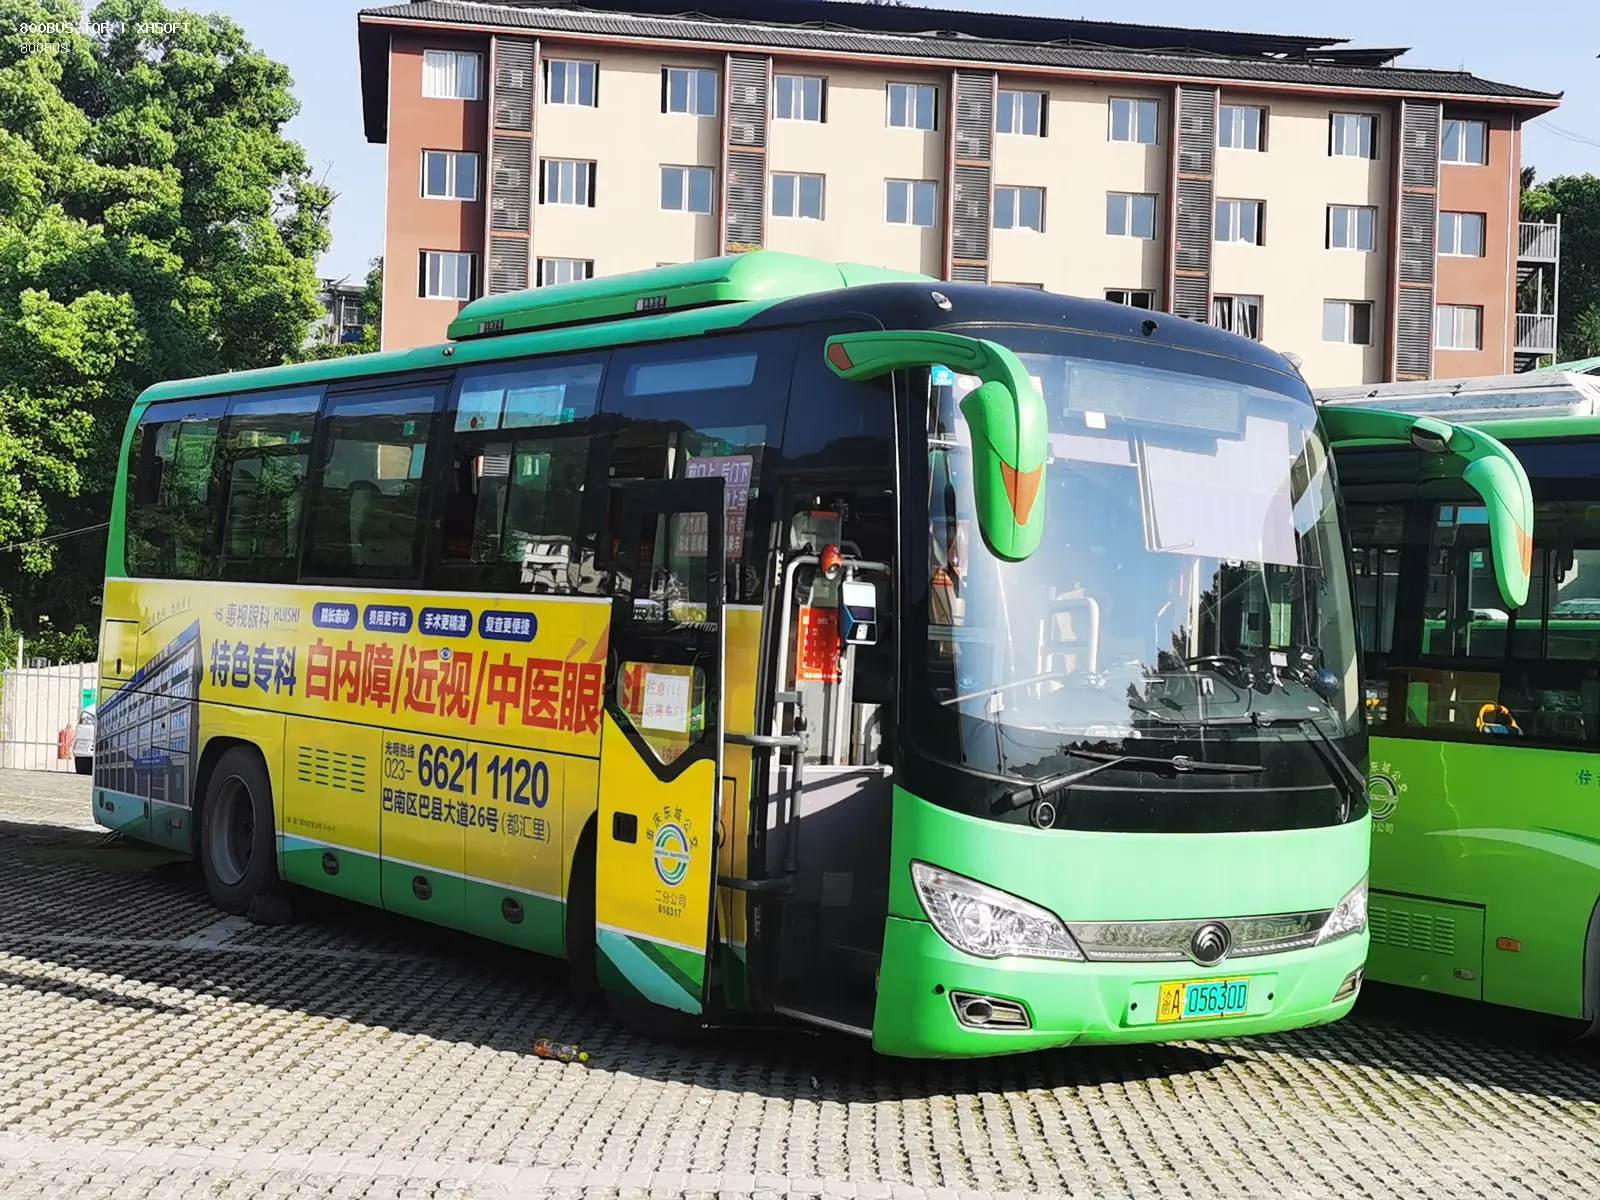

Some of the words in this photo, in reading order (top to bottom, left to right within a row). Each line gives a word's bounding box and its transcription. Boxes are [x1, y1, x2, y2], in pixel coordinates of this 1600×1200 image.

[274, 606, 300, 623] HUISHI
[368, 609, 408, 628] 费用更节省
[424, 613, 467, 632] 手术更精湛
[485, 616, 531, 635] 复查更便捷
[210, 639, 296, 697] 特色专科
[305, 637, 604, 736] 白内障/近视/中医眼
[385, 740, 415, 759] 光明热线
[654, 889, 687, 908] 二分公司
[658, 904, 682, 918] 010317
